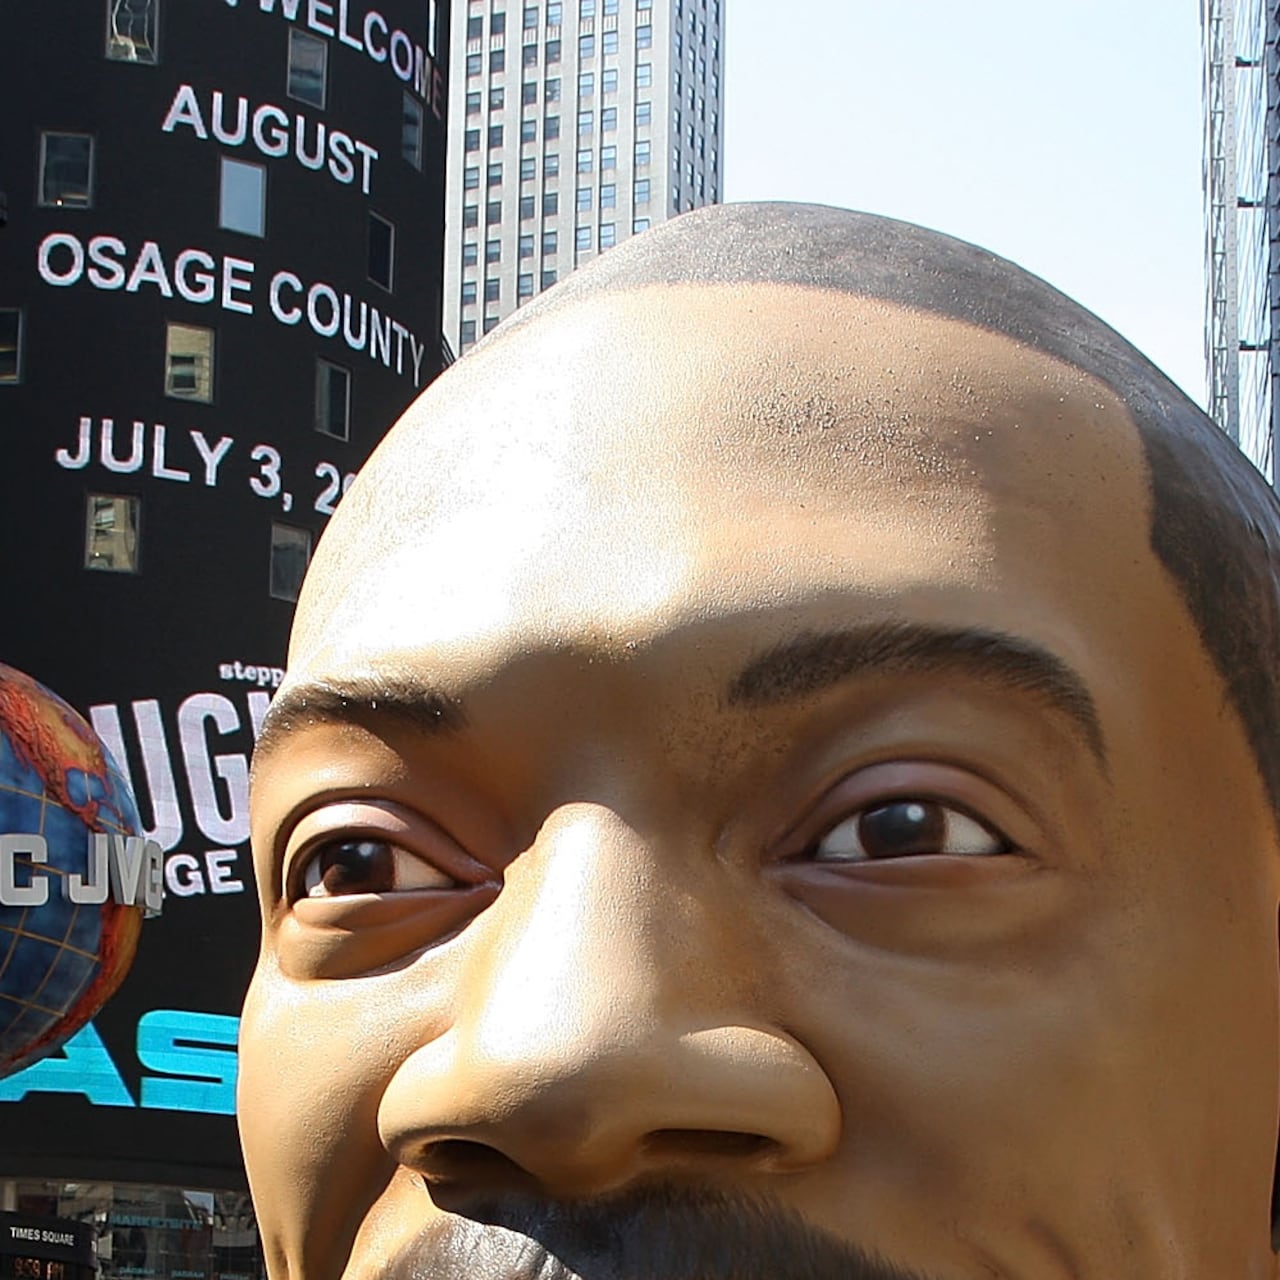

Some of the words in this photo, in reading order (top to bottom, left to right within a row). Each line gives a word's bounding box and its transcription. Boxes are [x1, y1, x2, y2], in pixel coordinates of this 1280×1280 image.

[162, 84, 379, 194] AUGUST
[37, 232, 255, 315] OSAGE
[269, 270, 425, 388] COUNTY
[55, 416, 234, 486] JULY
[249, 444, 293, 512] 3,
[90, 692, 270, 852] UG
[66, 832, 164, 916] JVC
[10, 1226, 41, 1241] TIMES
[42, 1230, 75, 1247] SQUARE
